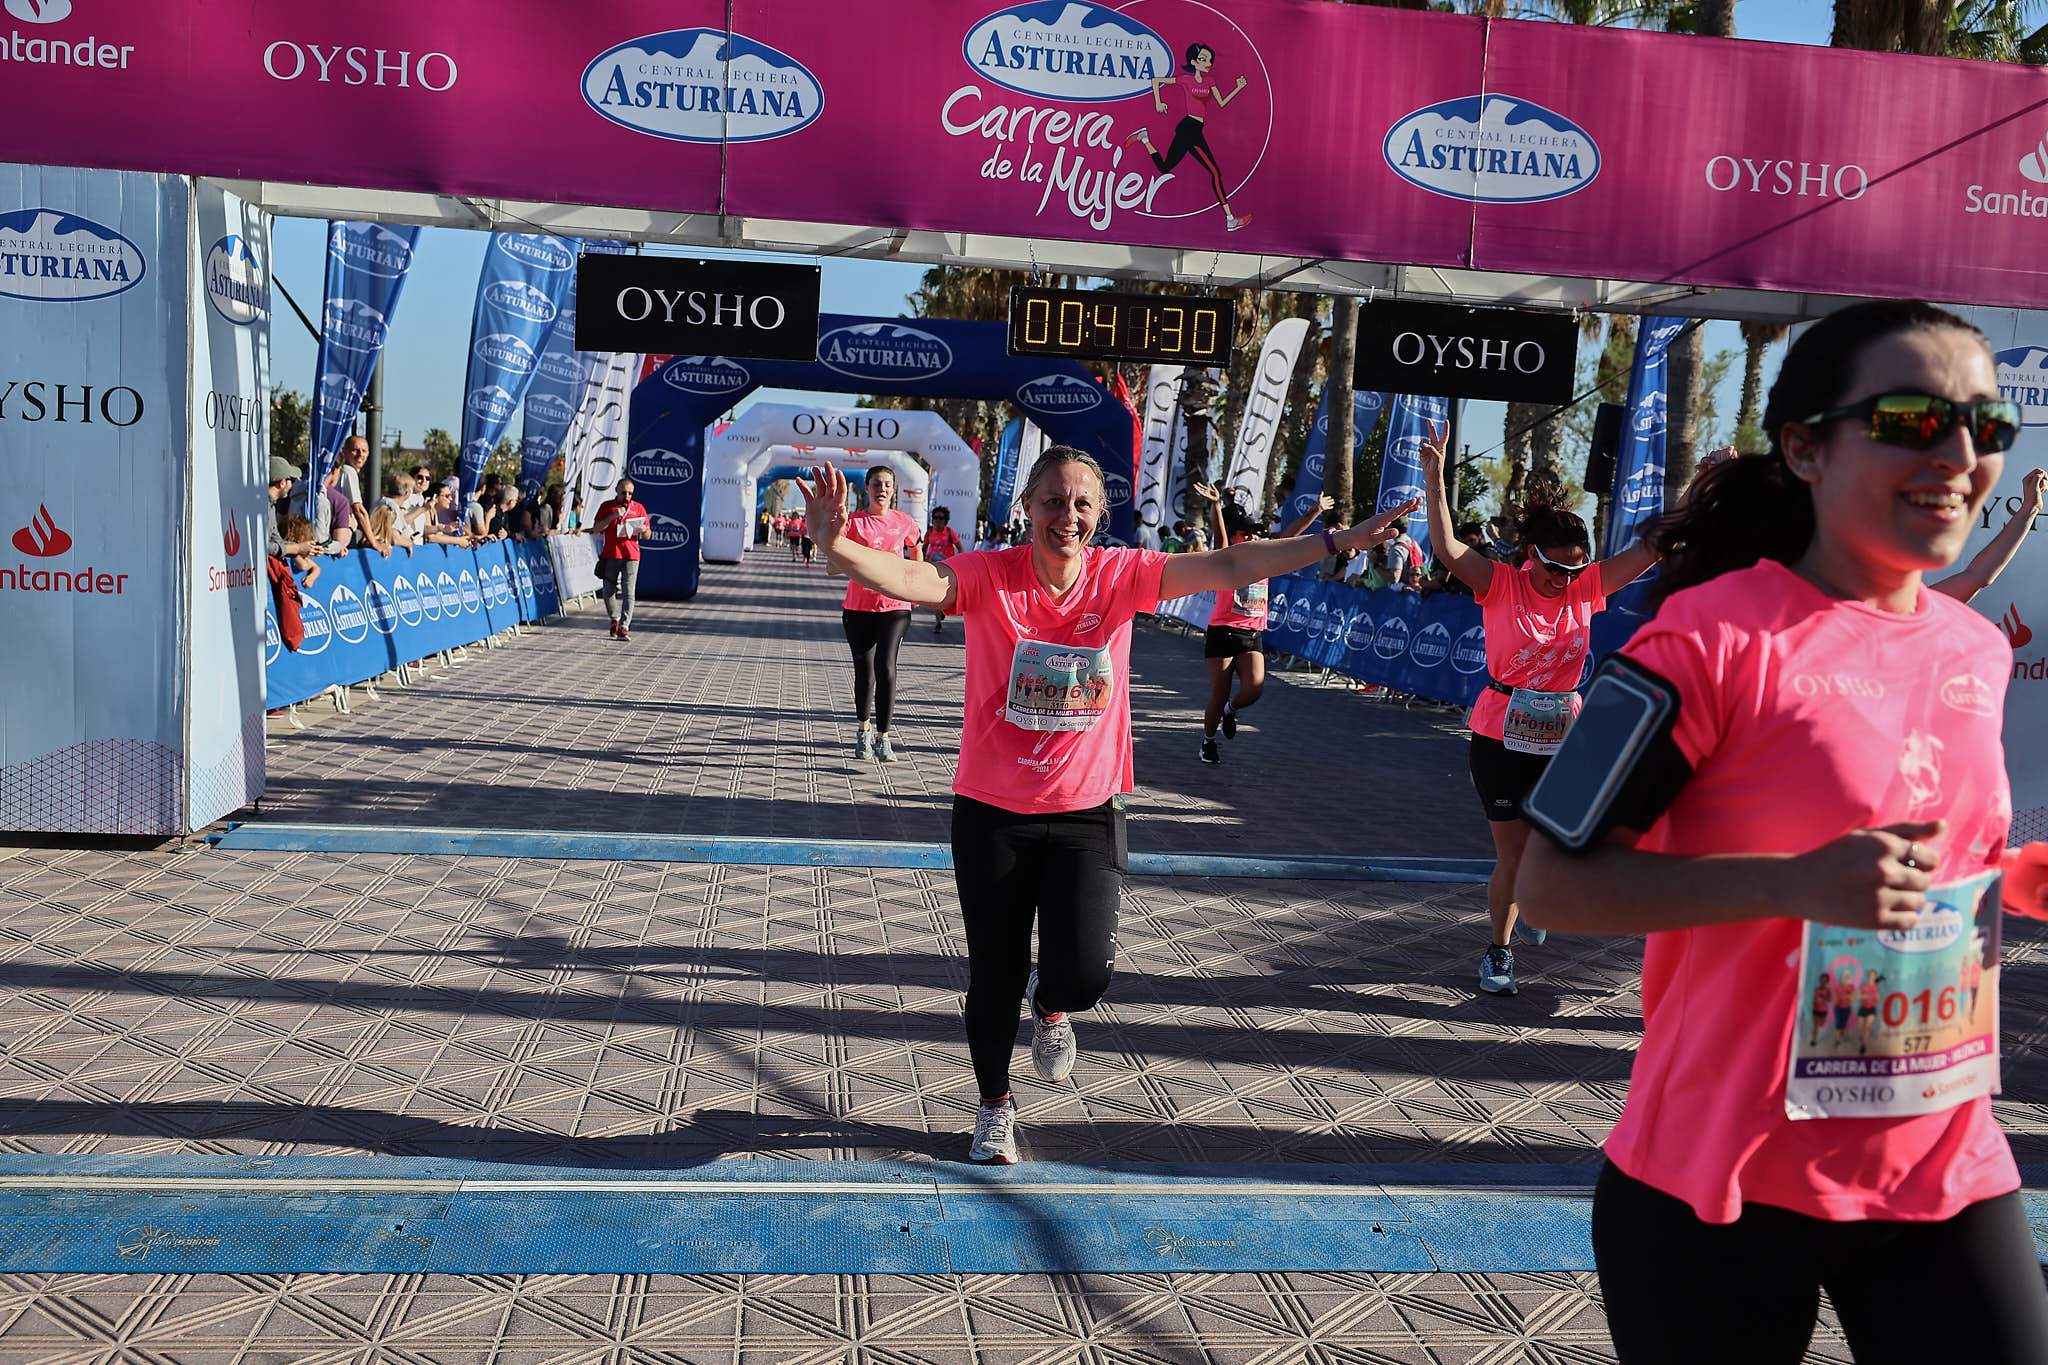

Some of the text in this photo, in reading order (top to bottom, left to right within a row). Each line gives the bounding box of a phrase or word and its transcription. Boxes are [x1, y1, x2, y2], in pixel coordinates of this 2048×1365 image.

[1013, 29, 1153, 51] CENTRAL LECHERA
[263, 40, 459, 92] OYSHO
[978, 29, 1155, 80] ASTURIANA
[638, 63, 799, 86] CENTRAL LECHERA
[599, 64, 805, 119] ASTURIANA
[941, 85, 1114, 149] Carrera
[1435, 127, 1579, 149] CENTRAL LECHERA
[1399, 127, 1584, 180] ASTURIANA
[980, 145, 1177, 232] de la Mujer
[1704, 155, 1868, 200] OYSHO
[59, 242, 124, 255] LECHERA
[0, 252, 131, 282] TURIANA
[616, 286, 785, 330] OYSHO
[1025, 299, 1217, 355] 00:41:30
[825, 337, 943, 369] ASTURIANA
[1392, 332, 1546, 374] OYSHO
[668, 367, 743, 387] ASTURIANA
[1023, 387, 1097, 405] ASTURIANA
[205, 390, 262, 435] OYSHO
[587, 351, 627, 491] OYSH
[792, 413, 900, 440] OYSHO
[727, 434, 760, 443] OYSHO
[929, 443, 962, 453] OYSHO
[630, 460, 689, 478] ASTURIANA
[943, 488, 973, 498] OYSHO
[208, 565, 256, 592] Santander
[1881, 985, 1957, 1028] 016
[1903, 1035, 1932, 1053] 577
[1806, 1060, 1868, 1075] CARRERA
[1870, 1059, 1888, 1074] DE
[1891, 1058, 1908, 1074] LA
[1815, 1085, 1895, 1104] OYSHO
